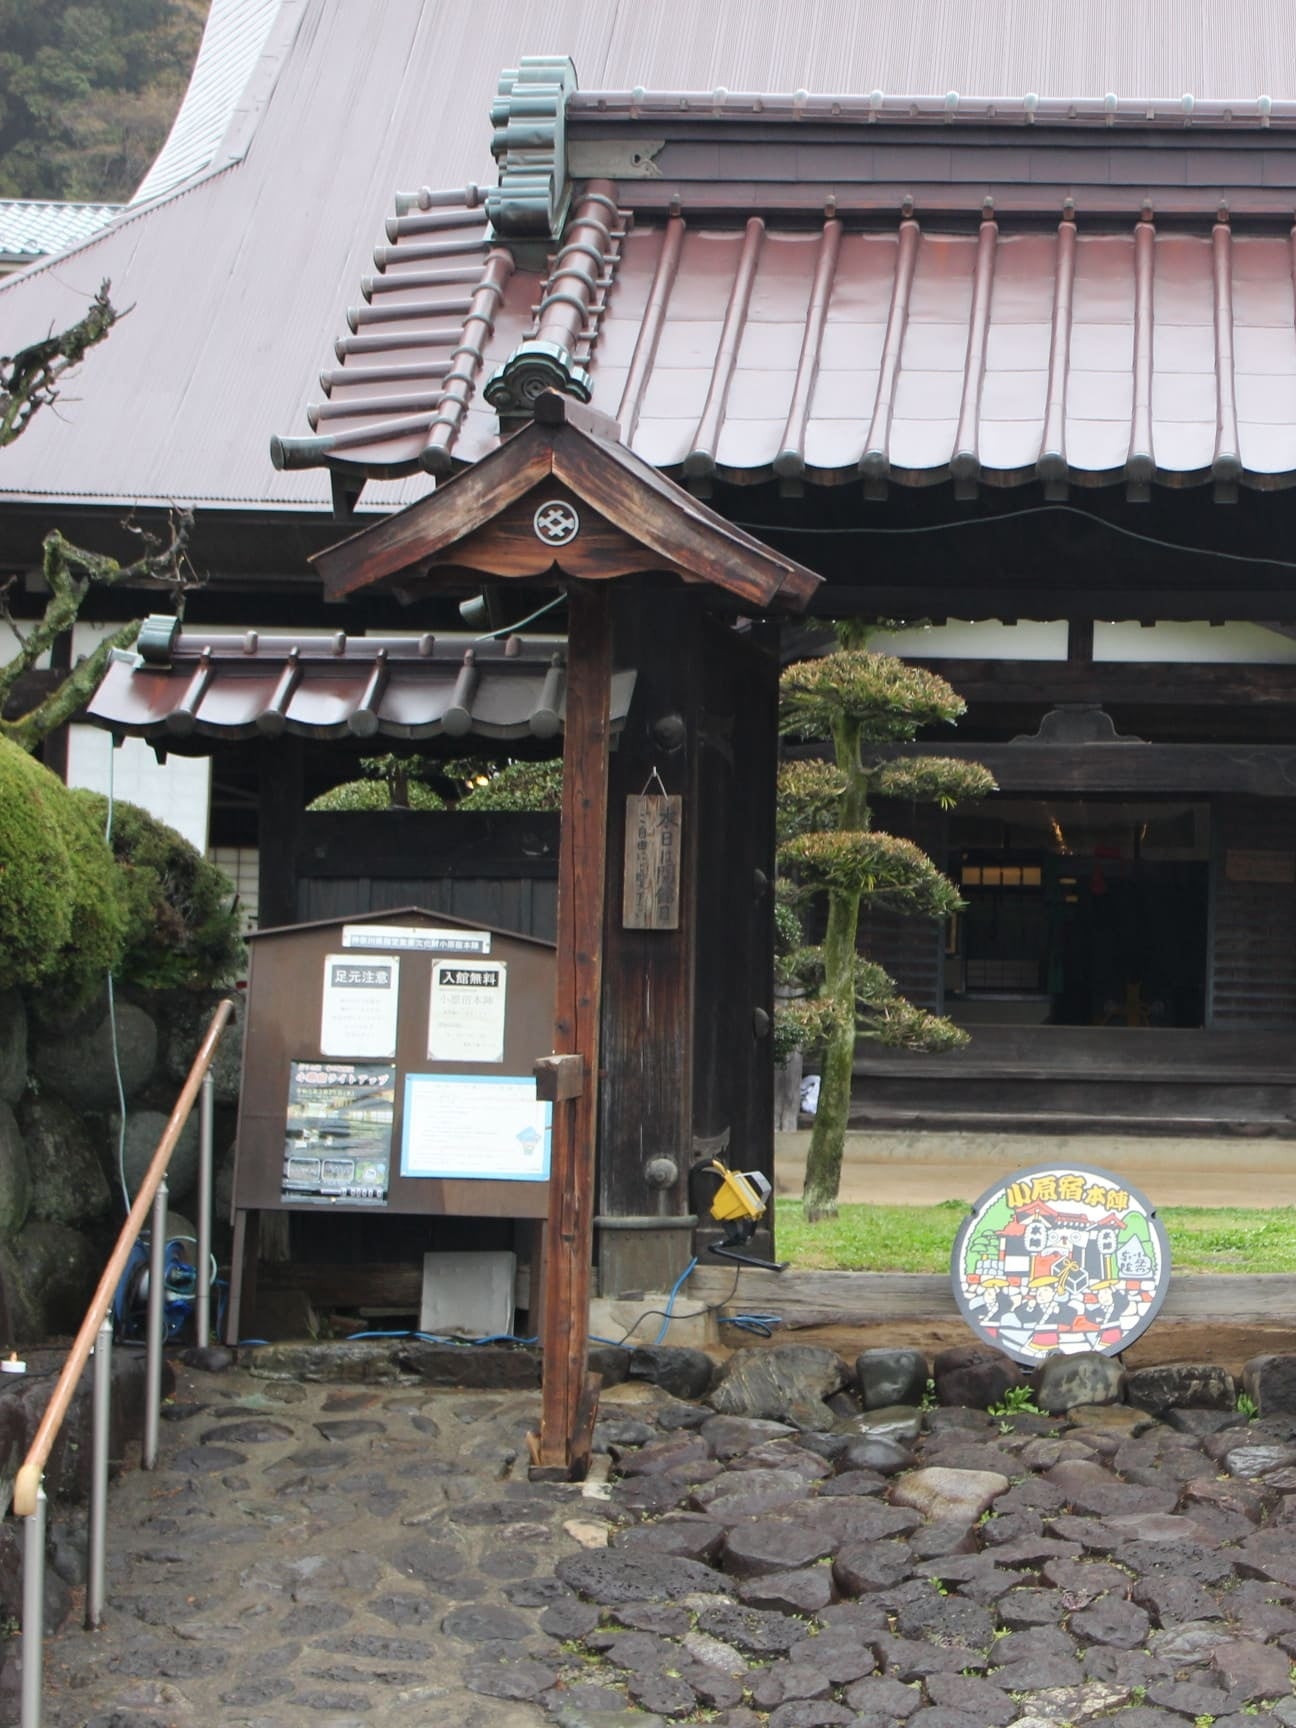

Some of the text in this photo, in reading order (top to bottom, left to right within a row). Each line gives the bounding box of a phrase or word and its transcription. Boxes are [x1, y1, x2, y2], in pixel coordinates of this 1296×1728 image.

[335, 970, 388, 985] 足元注意
[442, 971, 496, 985] 入館無料
[1005, 1174, 1130, 1212] 小原宿本陣
